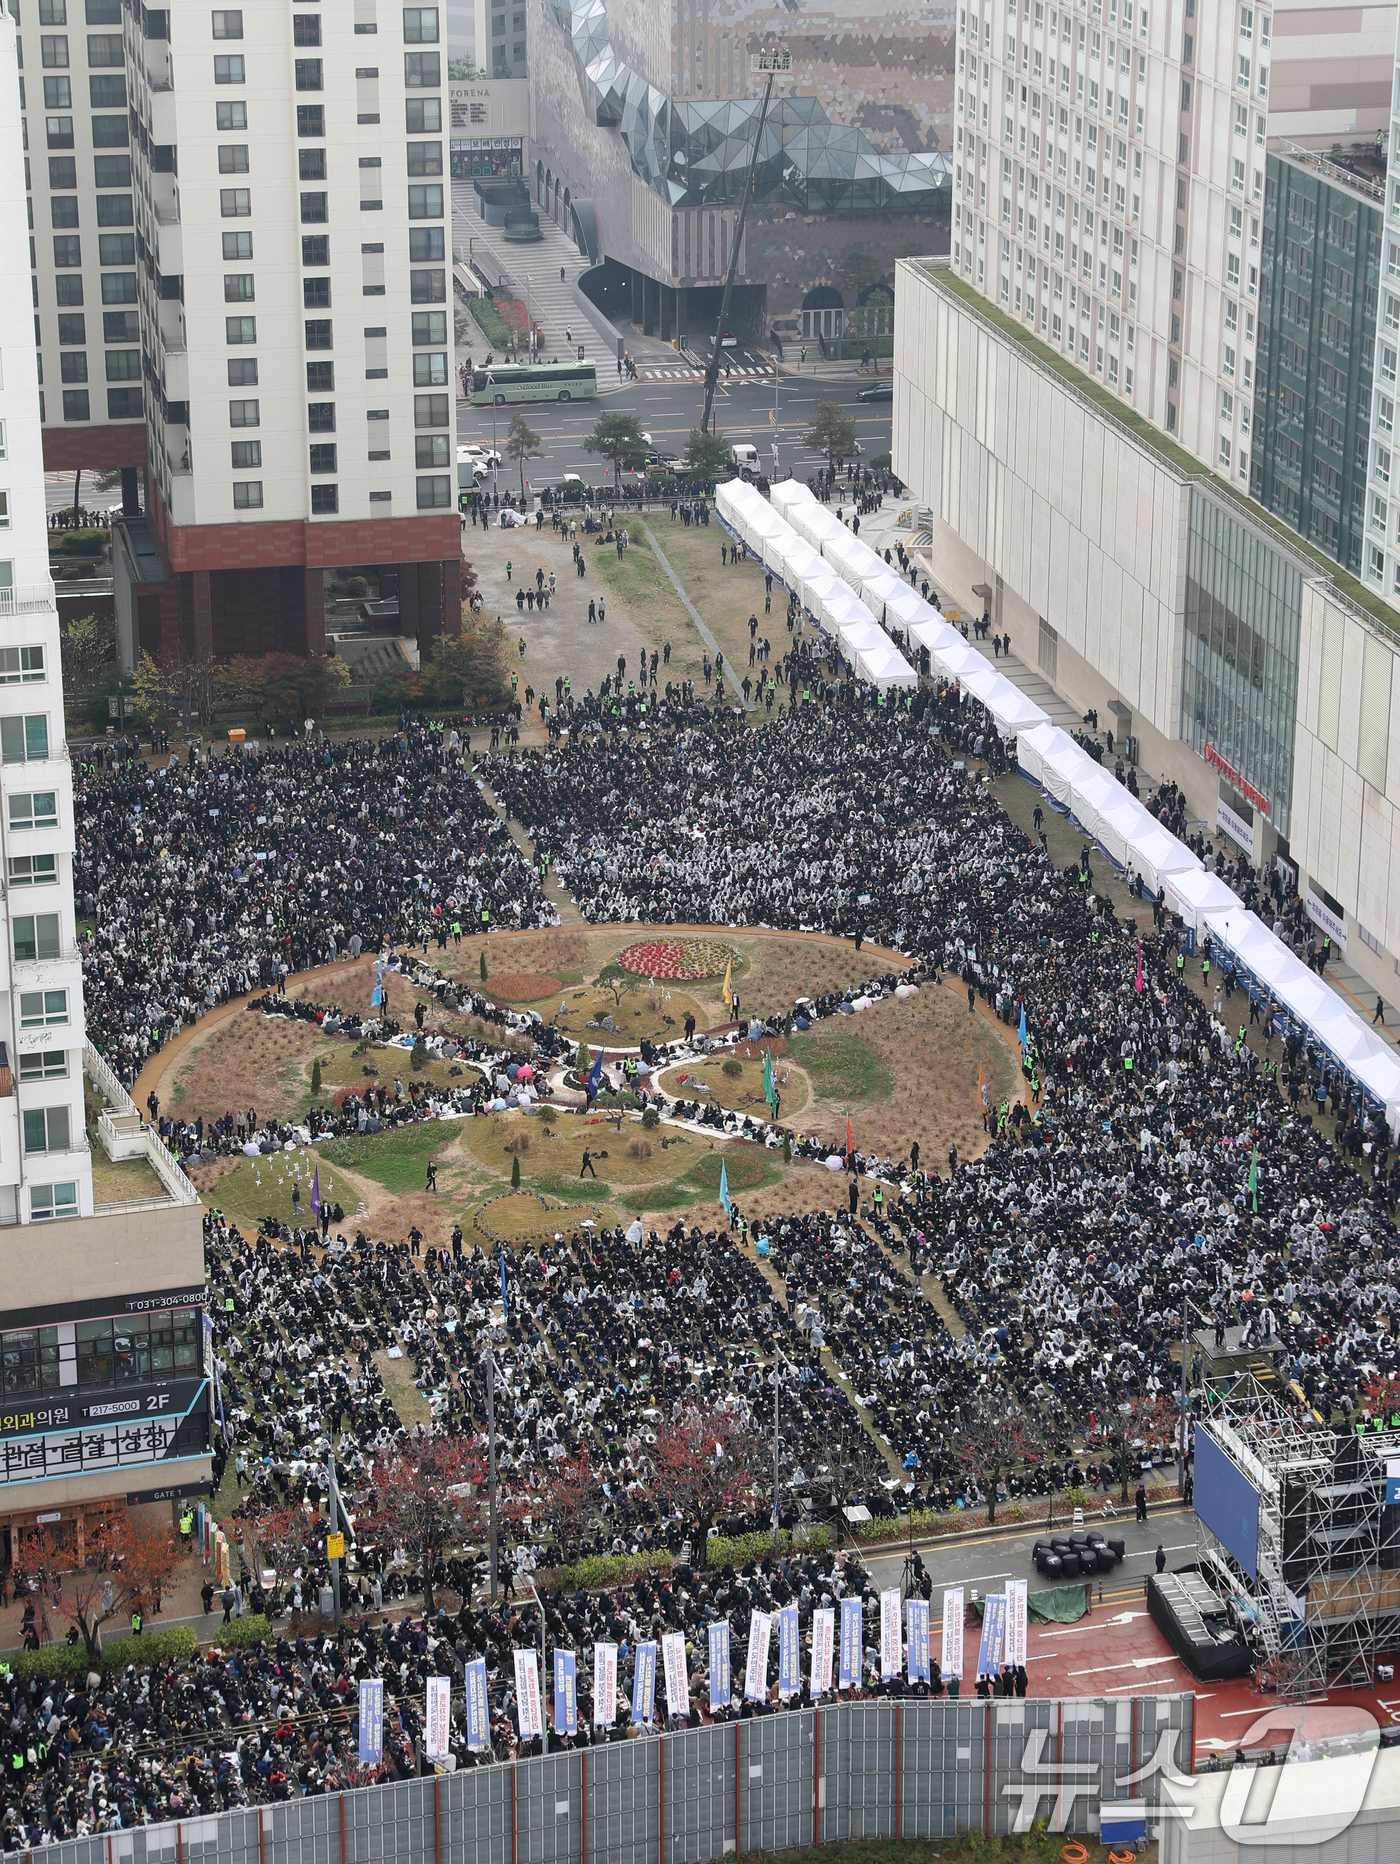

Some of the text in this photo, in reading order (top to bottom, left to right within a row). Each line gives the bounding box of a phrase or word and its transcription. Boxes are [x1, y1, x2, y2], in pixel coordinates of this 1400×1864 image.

[450, 89, 490, 98] FORENA
[1211, 751, 1269, 816] LOTTE CINEMA
[129, 1292, 208, 1310] T 031-304-0800
[82, 1408, 88, 1416] T
[92, 1401, 137, 1415] 217-5000
[146, 1394, 170, 1410] 2F
[154, 1491, 174, 1499] GATE
